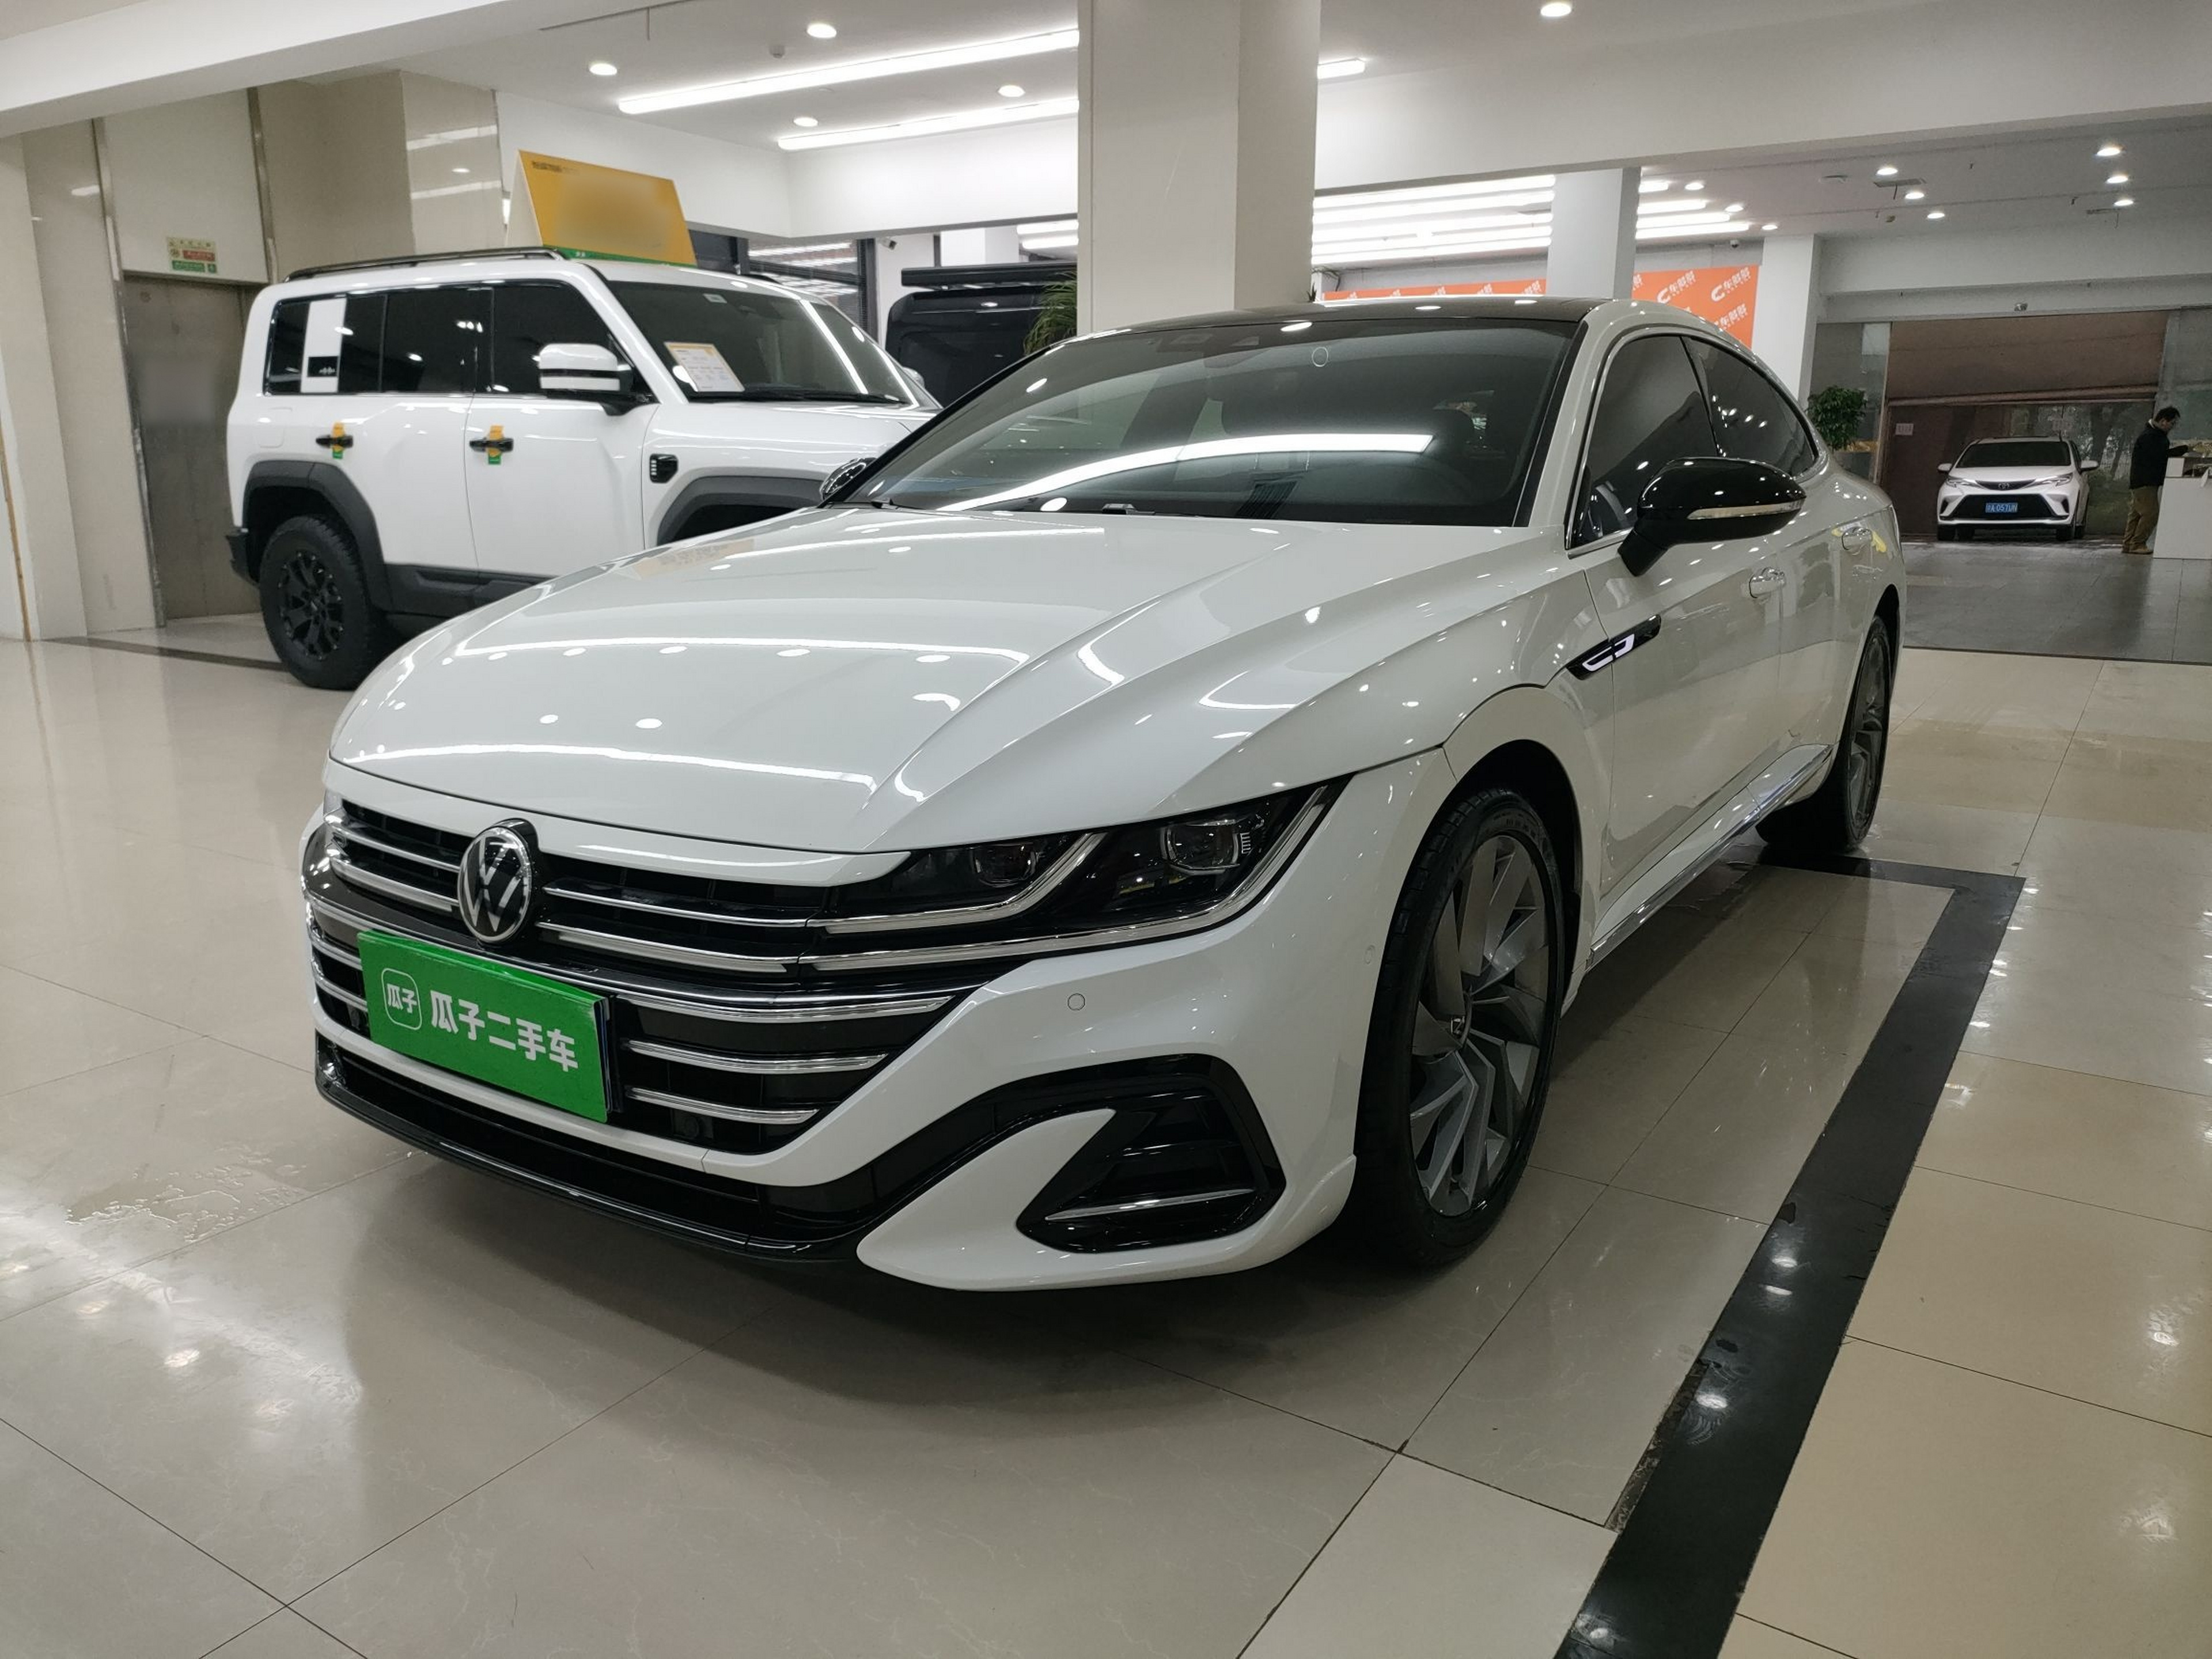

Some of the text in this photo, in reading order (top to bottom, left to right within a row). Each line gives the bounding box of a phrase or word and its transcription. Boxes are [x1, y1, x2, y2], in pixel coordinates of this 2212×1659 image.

[387, 983, 418, 1014] 瓜子
[430, 990, 578, 1073] 瓜子二手车
